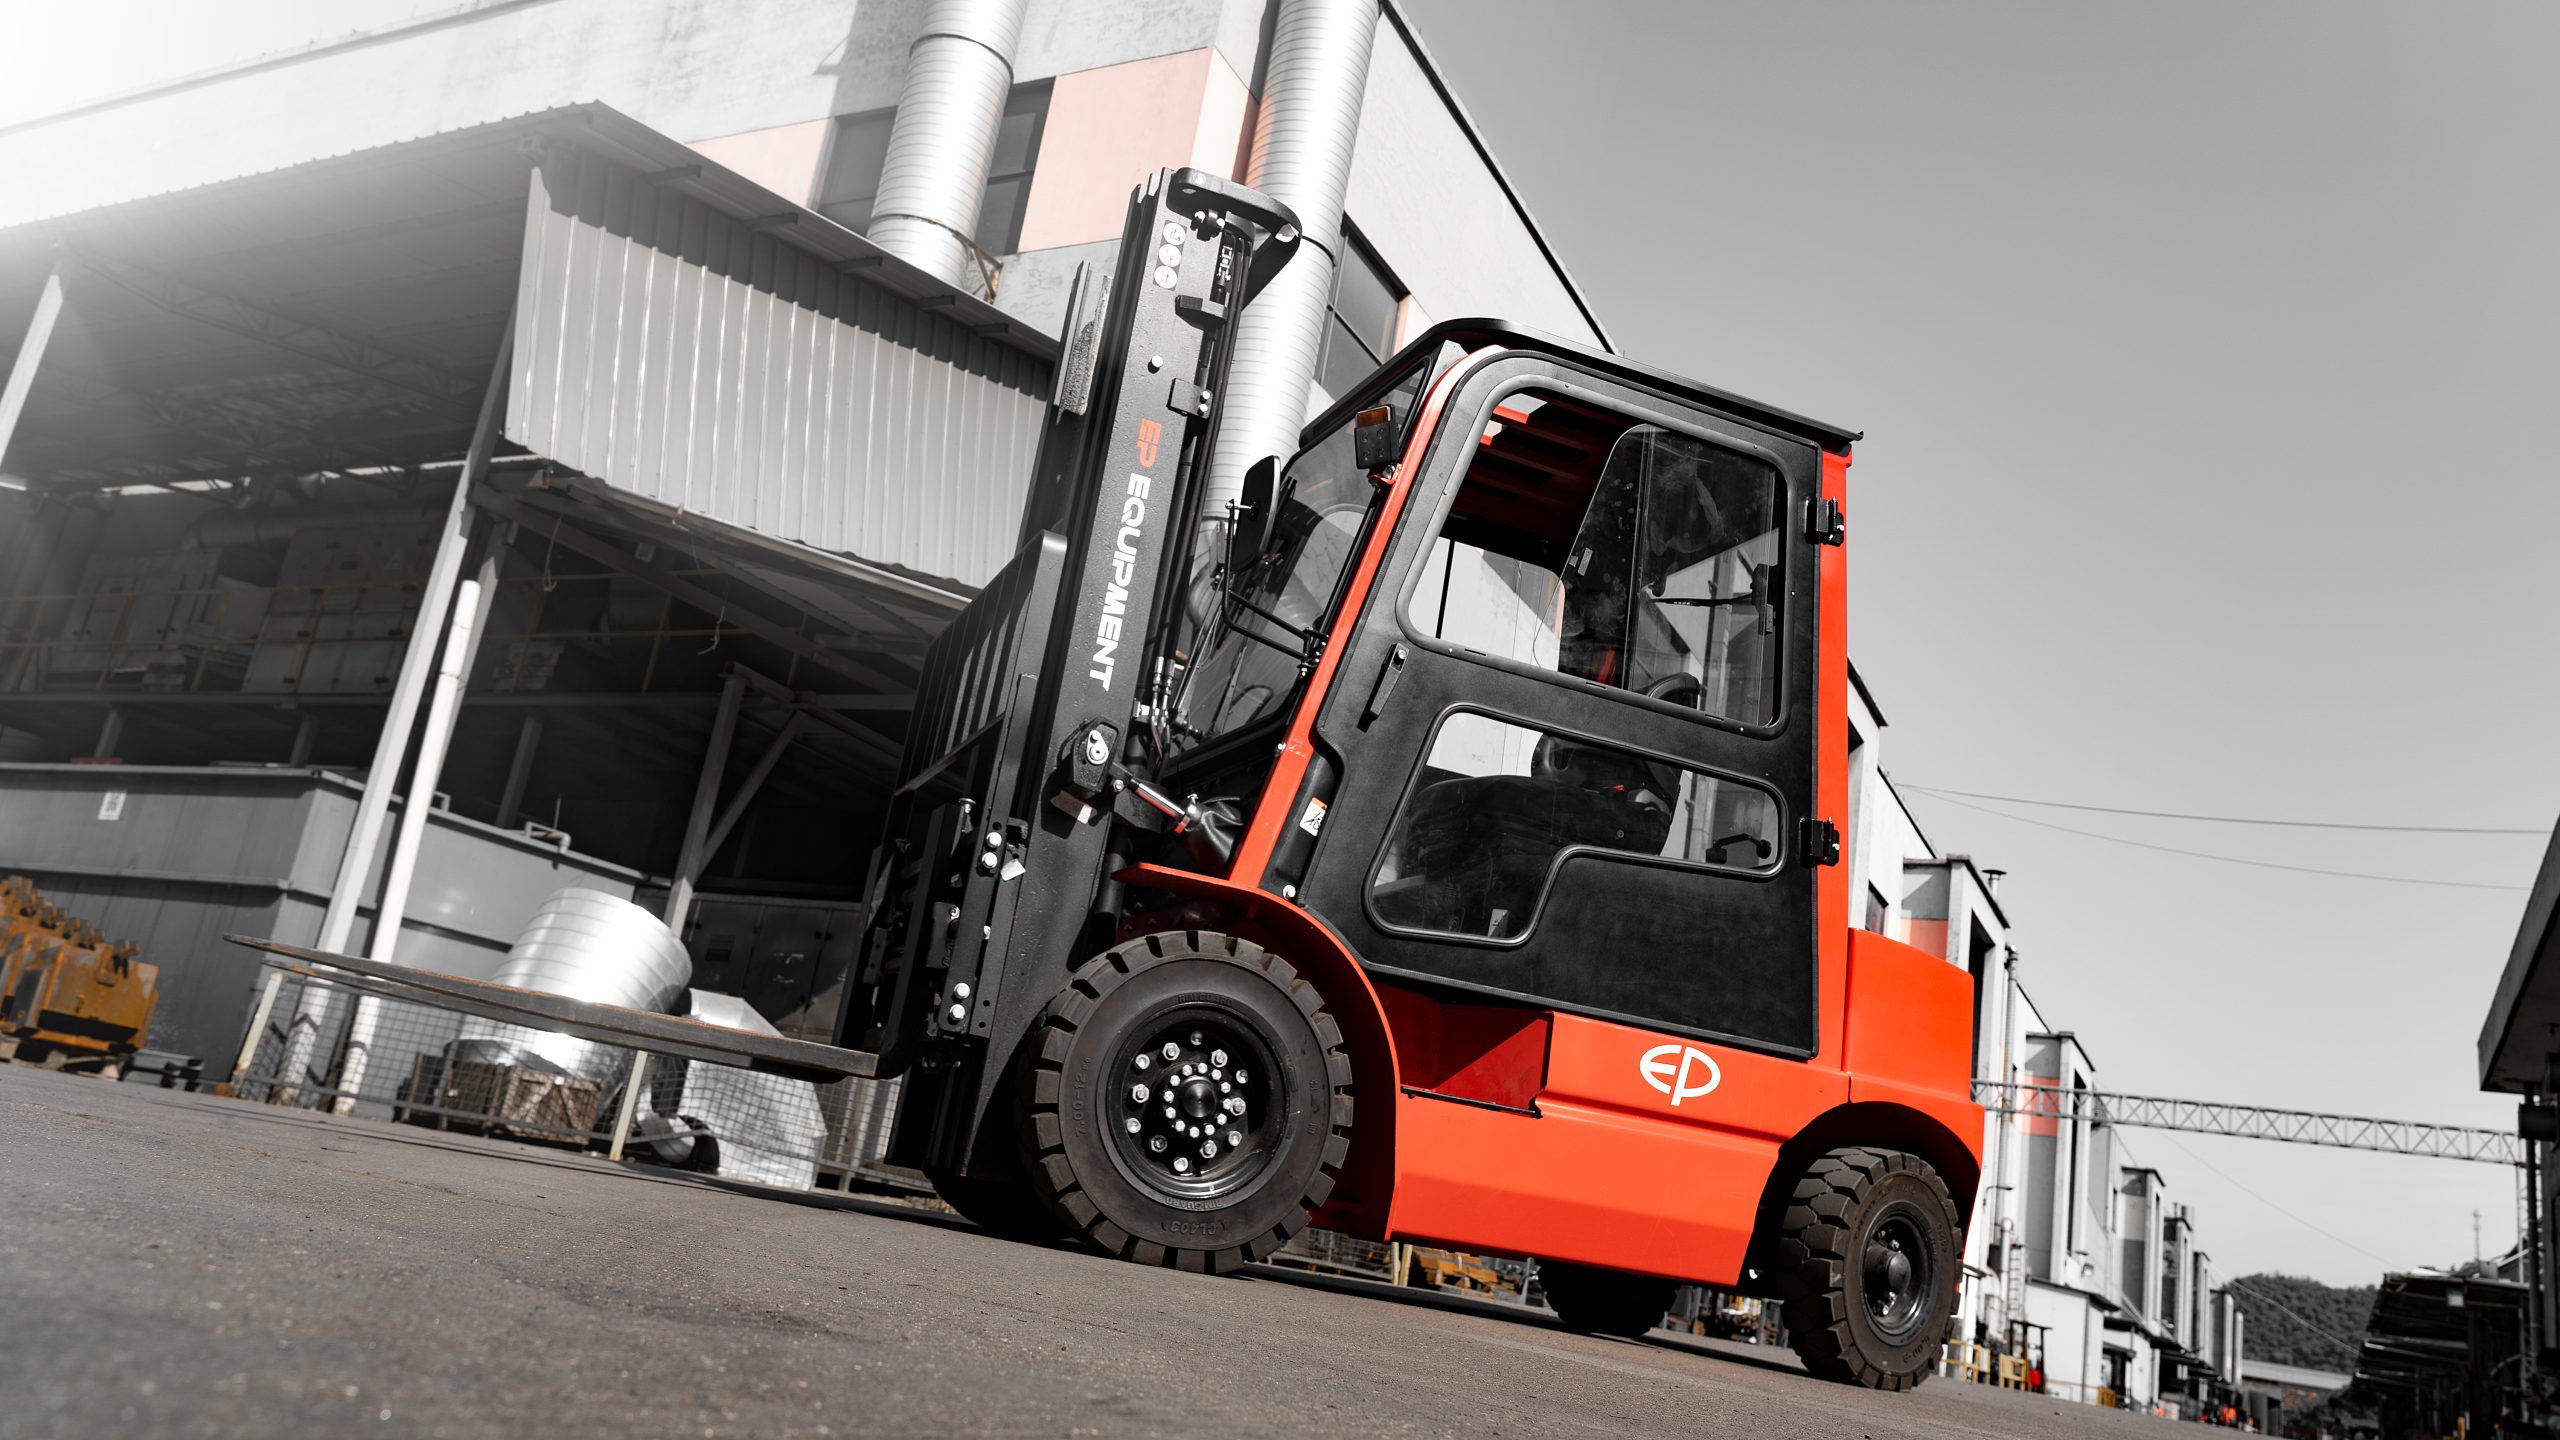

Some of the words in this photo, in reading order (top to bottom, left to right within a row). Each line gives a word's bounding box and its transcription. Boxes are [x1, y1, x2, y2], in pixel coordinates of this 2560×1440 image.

[1137, 418, 1162, 468] EP
[1090, 472, 1151, 691] EQUIPMENT
[1640, 1044, 1721, 1106] EP
